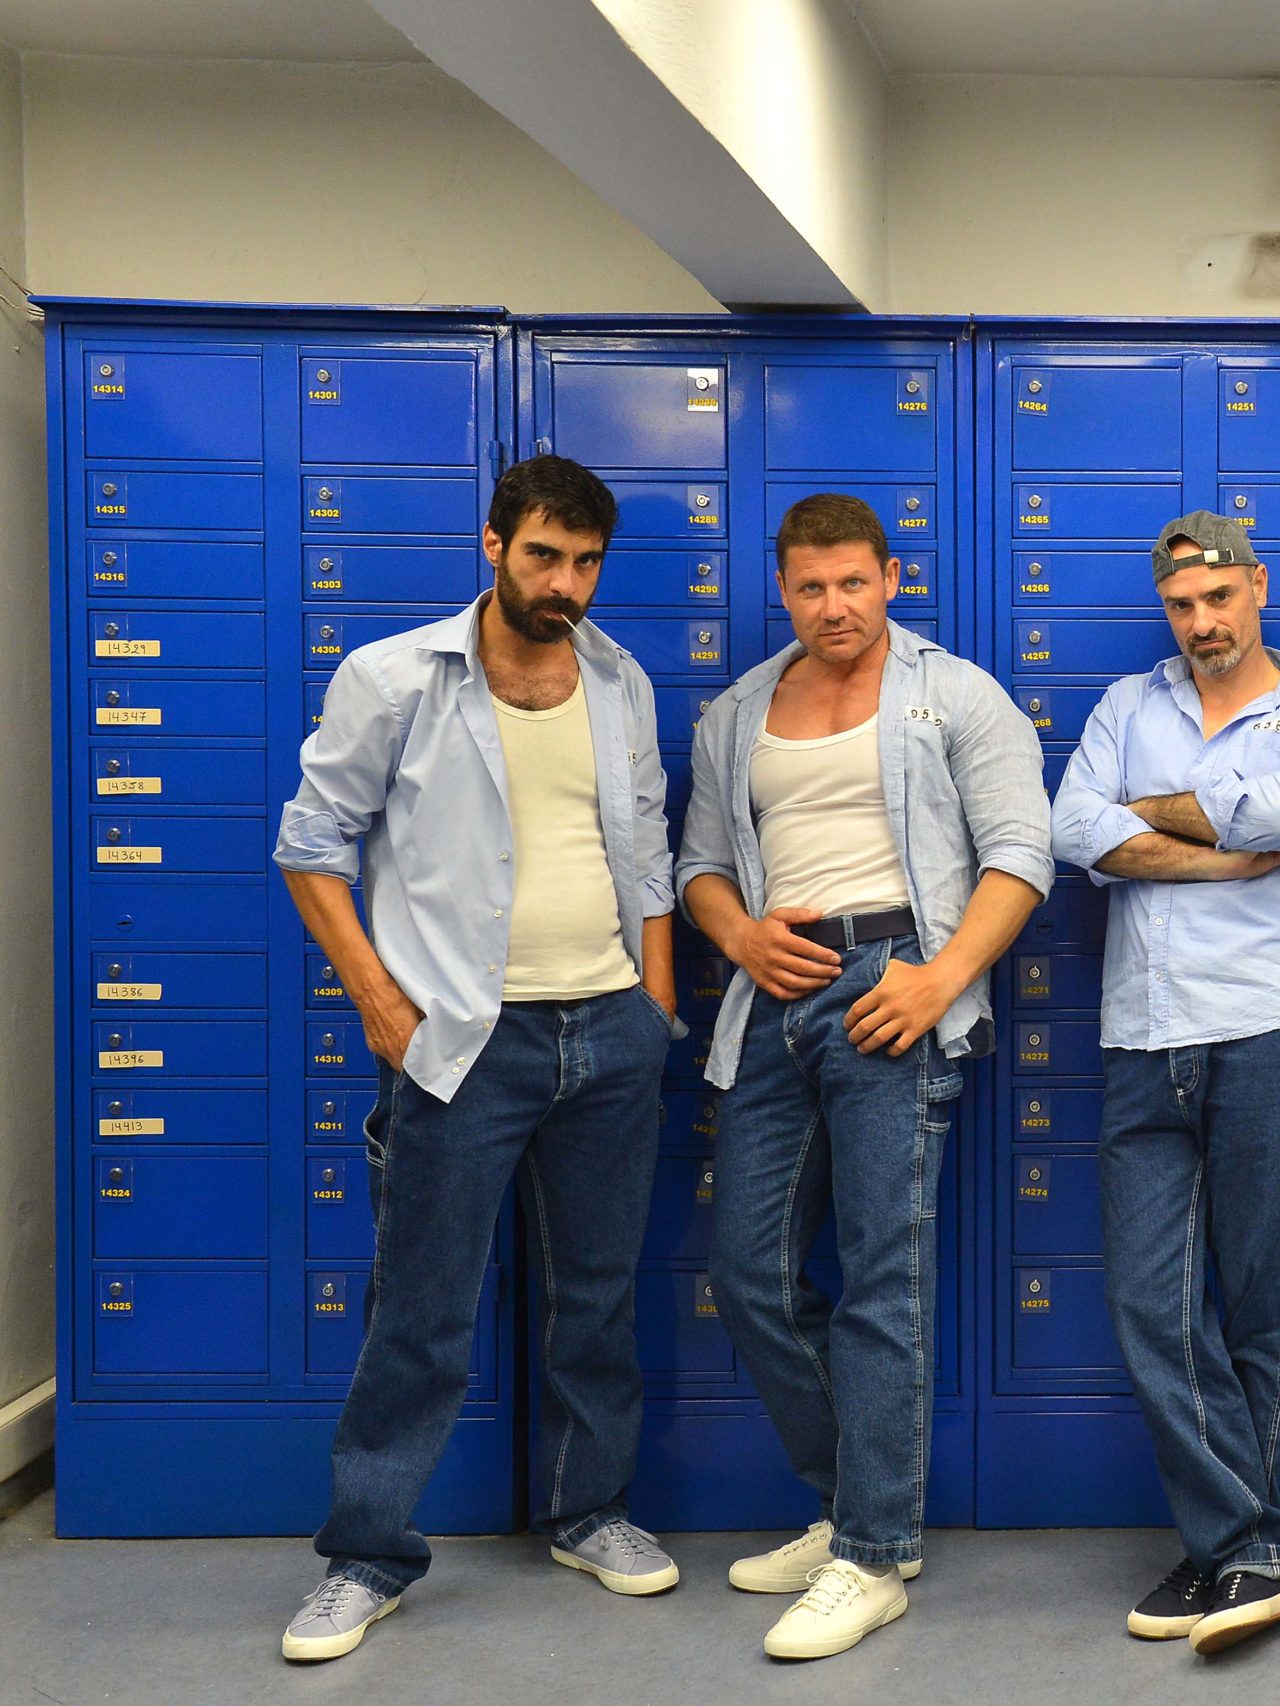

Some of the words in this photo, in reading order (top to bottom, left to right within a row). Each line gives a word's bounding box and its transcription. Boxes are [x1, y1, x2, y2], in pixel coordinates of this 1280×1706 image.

[92, 384, 125, 394] 14314
[308, 390, 338, 400] 14301
[898, 401, 928, 412] 14276
[1018, 400, 1048, 412] 14264
[1227, 402, 1255, 412] 14251
[95, 505, 127, 514] 14315
[309, 508, 341, 518] 14302
[689, 514, 719, 525] 14289
[898, 518, 928, 529] 14277
[1020, 515, 1050, 525] 14265
[1235, 517, 1255, 527] 252
[94, 572, 125, 582] 14316
[311, 579, 343, 589] 14303
[1020, 583, 1050, 593] 14266
[689, 584, 720, 595] 14290
[898, 585, 929, 595] 14278
[108, 642, 146, 655] 14329
[311, 645, 341, 655] 14304
[690, 650, 720, 661] 14291
[1021, 650, 1051, 661] 14267
[108, 711, 147, 723] 14347
[1032, 717, 1052, 728] 268
[107, 781, 144, 792] 14358
[107, 850, 142, 861] 14364
[107, 986, 143, 998] 14386
[313, 987, 343, 997] 14309
[1021, 985, 1049, 995] 14271
[108, 1054, 144, 1065] 14396
[314, 1055, 344, 1064] 14310
[1020, 1051, 1049, 1061] 14272
[111, 1121, 143, 1132] 14413
[314, 1121, 342, 1131] 14311
[1021, 1118, 1051, 1127] 14273
[101, 1188, 131, 1198] 14324
[313, 1190, 344, 1199] 14312
[695, 1188, 713, 1198] 142
[1019, 1187, 1048, 1198] 14274
[101, 1301, 132, 1311] 14325
[314, 1303, 345, 1312] 14313
[1020, 1299, 1050, 1309] 14275
